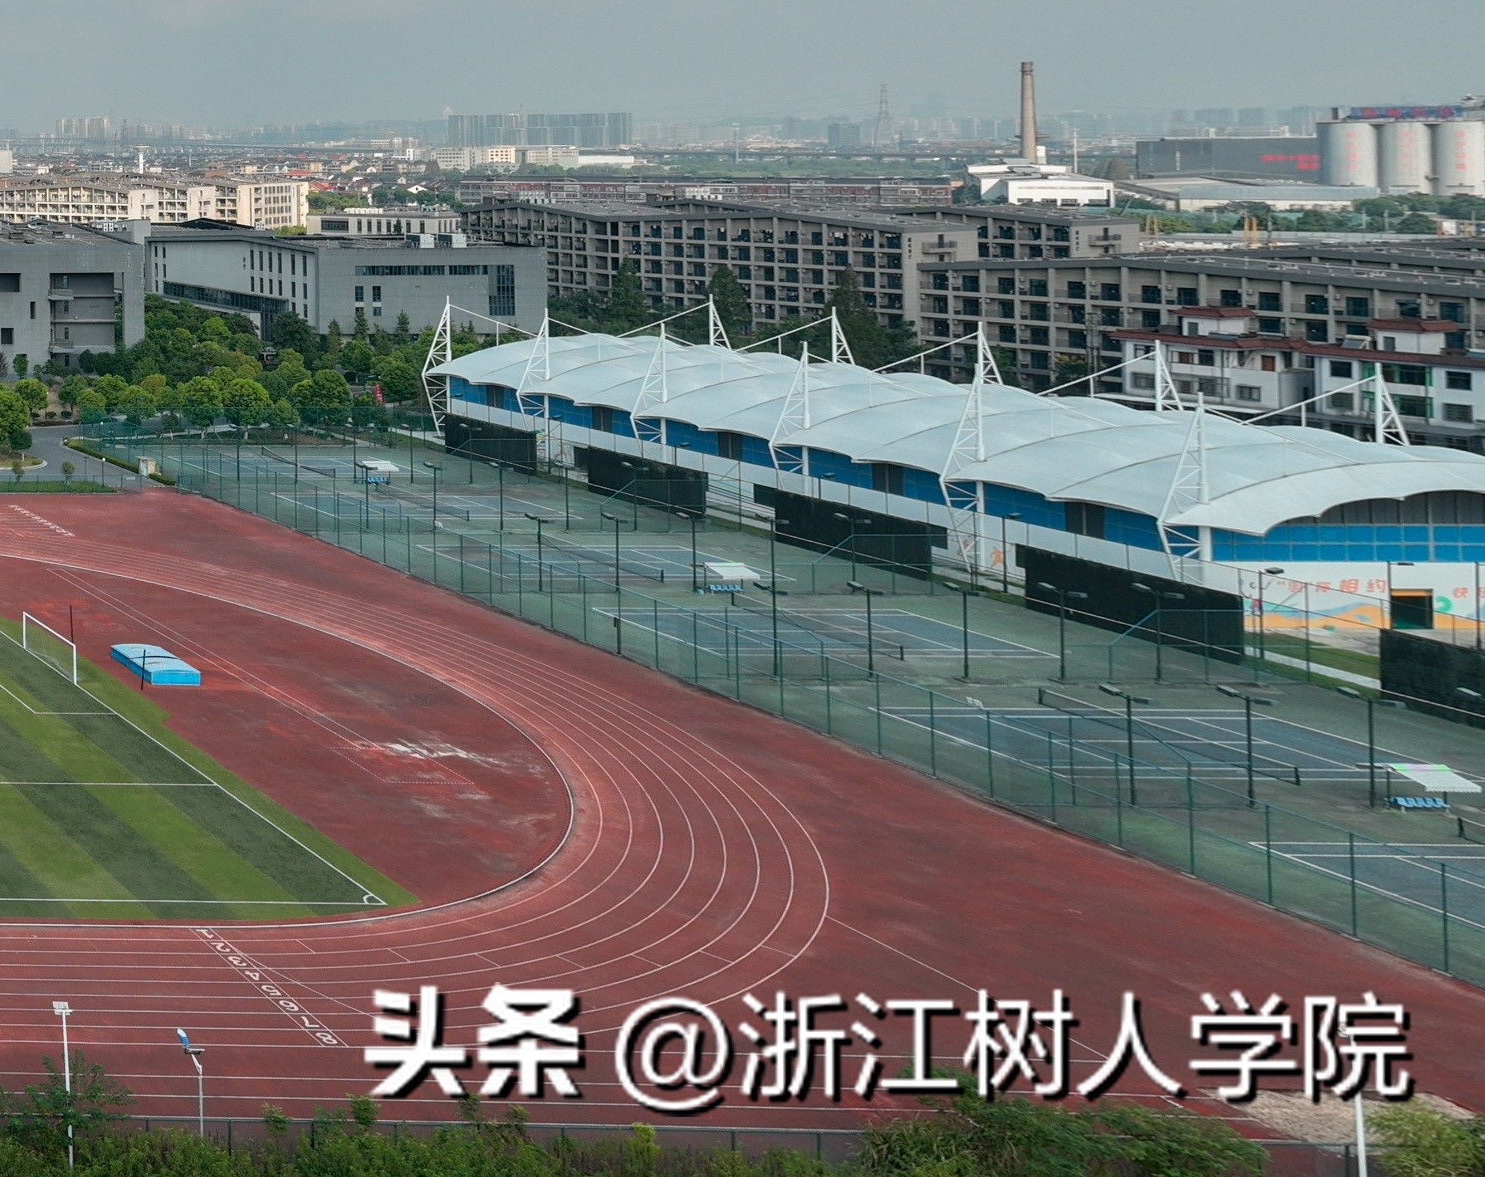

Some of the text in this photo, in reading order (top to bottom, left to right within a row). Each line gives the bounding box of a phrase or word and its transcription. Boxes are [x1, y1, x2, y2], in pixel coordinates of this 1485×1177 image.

[196, 929, 338, 1045] 1 2 3 4 5 6 7 8
